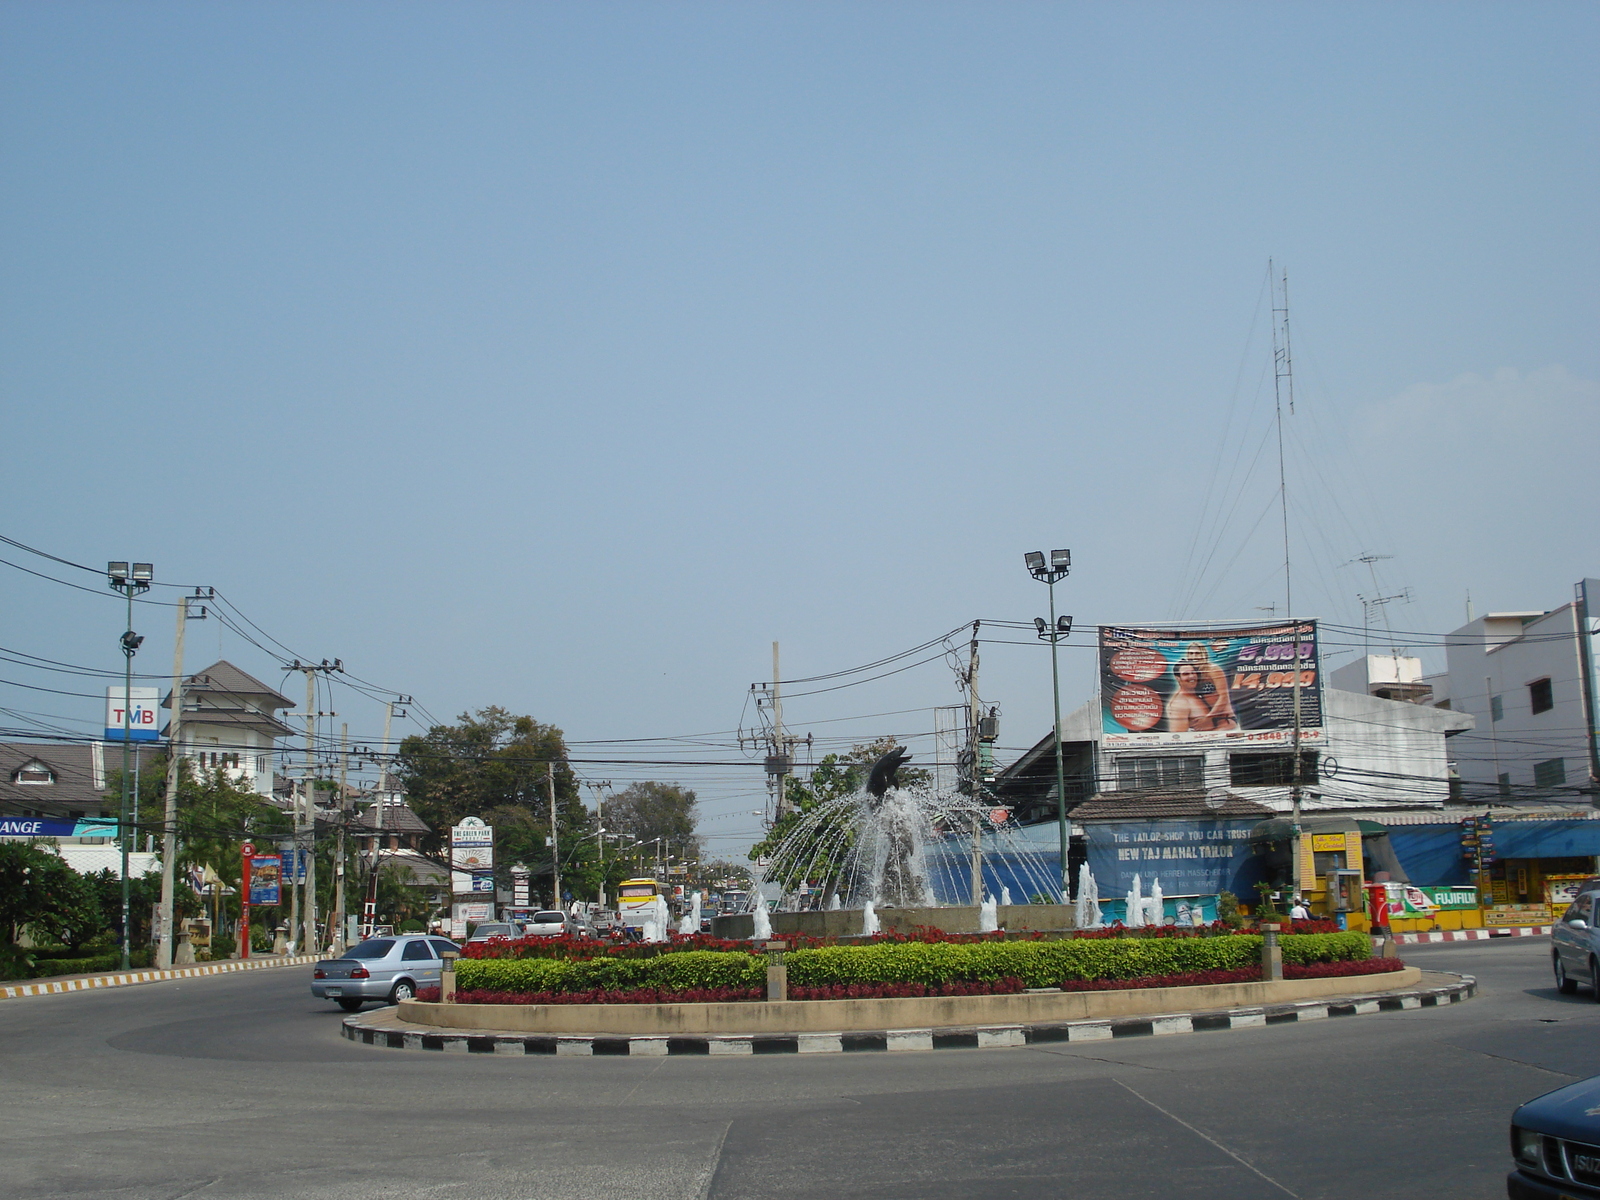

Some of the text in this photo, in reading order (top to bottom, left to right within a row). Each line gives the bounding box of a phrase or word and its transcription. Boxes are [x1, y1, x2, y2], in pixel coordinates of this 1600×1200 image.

[1237, 643, 1314, 664] 5,999
[1231, 670, 1316, 692] 14,999
[113, 705, 154, 724] TMB
[0, 821, 42, 834] ANGE
[1113, 829, 1251, 843] THE TAILOR SHOP YOU CAN TRUST
[1118, 845, 1233, 861] NEW TAJ MAHAL TAILOR
[1120, 871, 1142, 879] DAMN
[1434, 892, 1477, 904] FUJIFILM
